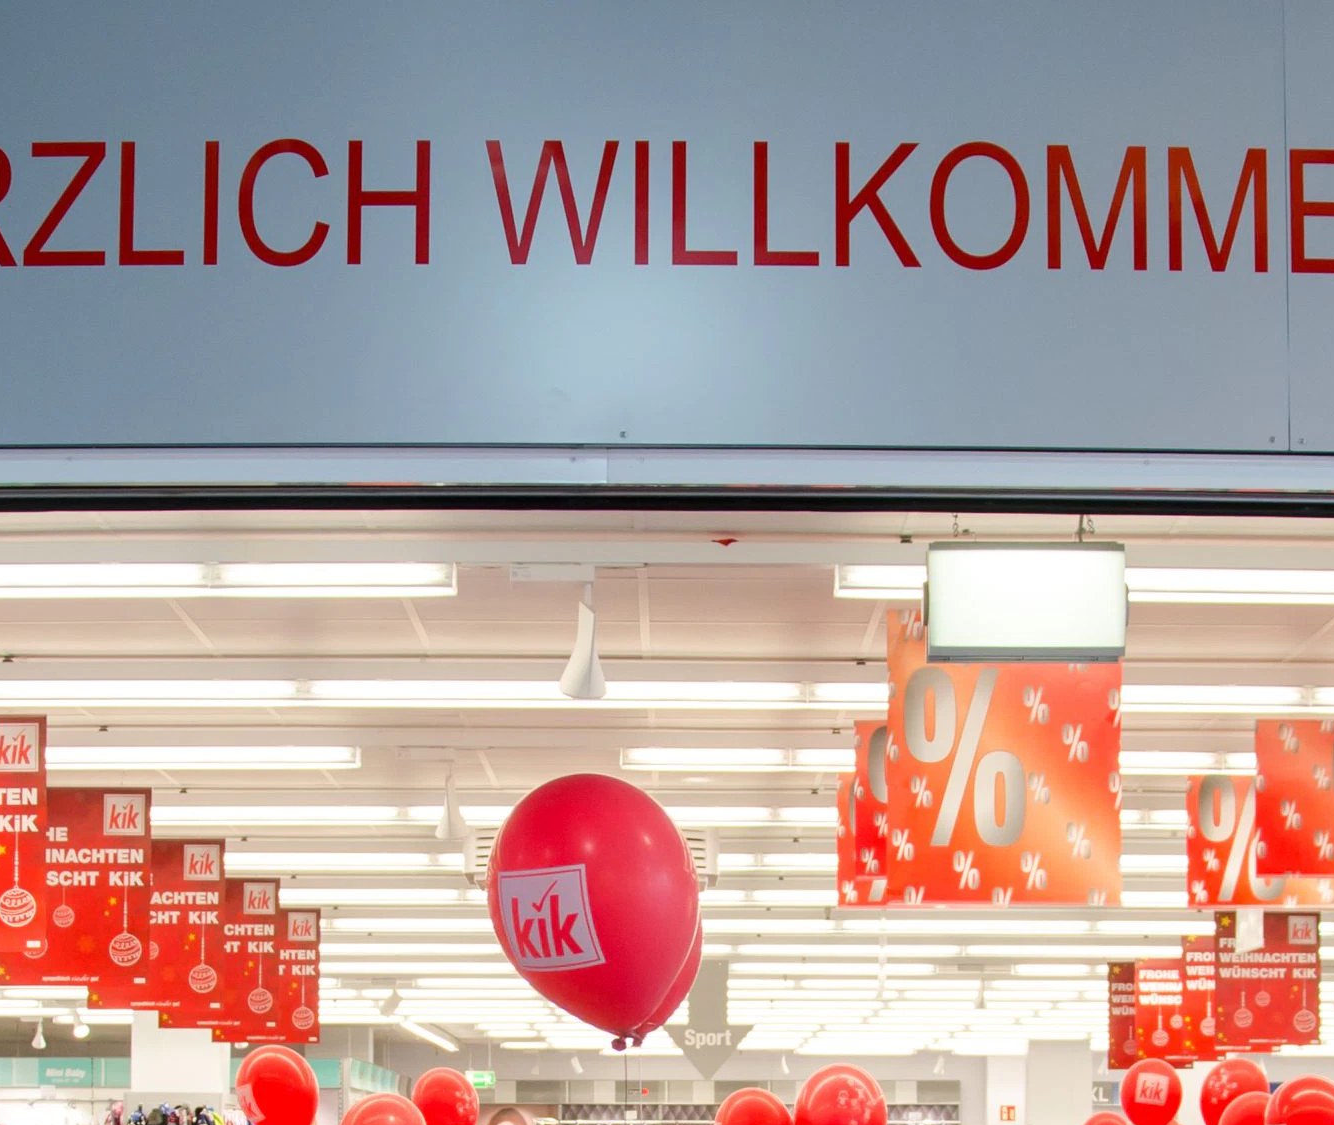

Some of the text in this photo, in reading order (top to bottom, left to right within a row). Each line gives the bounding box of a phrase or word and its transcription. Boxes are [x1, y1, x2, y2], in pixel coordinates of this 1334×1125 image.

[511, 879, 583, 959] kik
[1219, 952, 1317, 964] WEIHNACHTEN
[1219, 966, 1287, 979] WÜNSCHT
[685, 1028, 732, 1050] Sport
